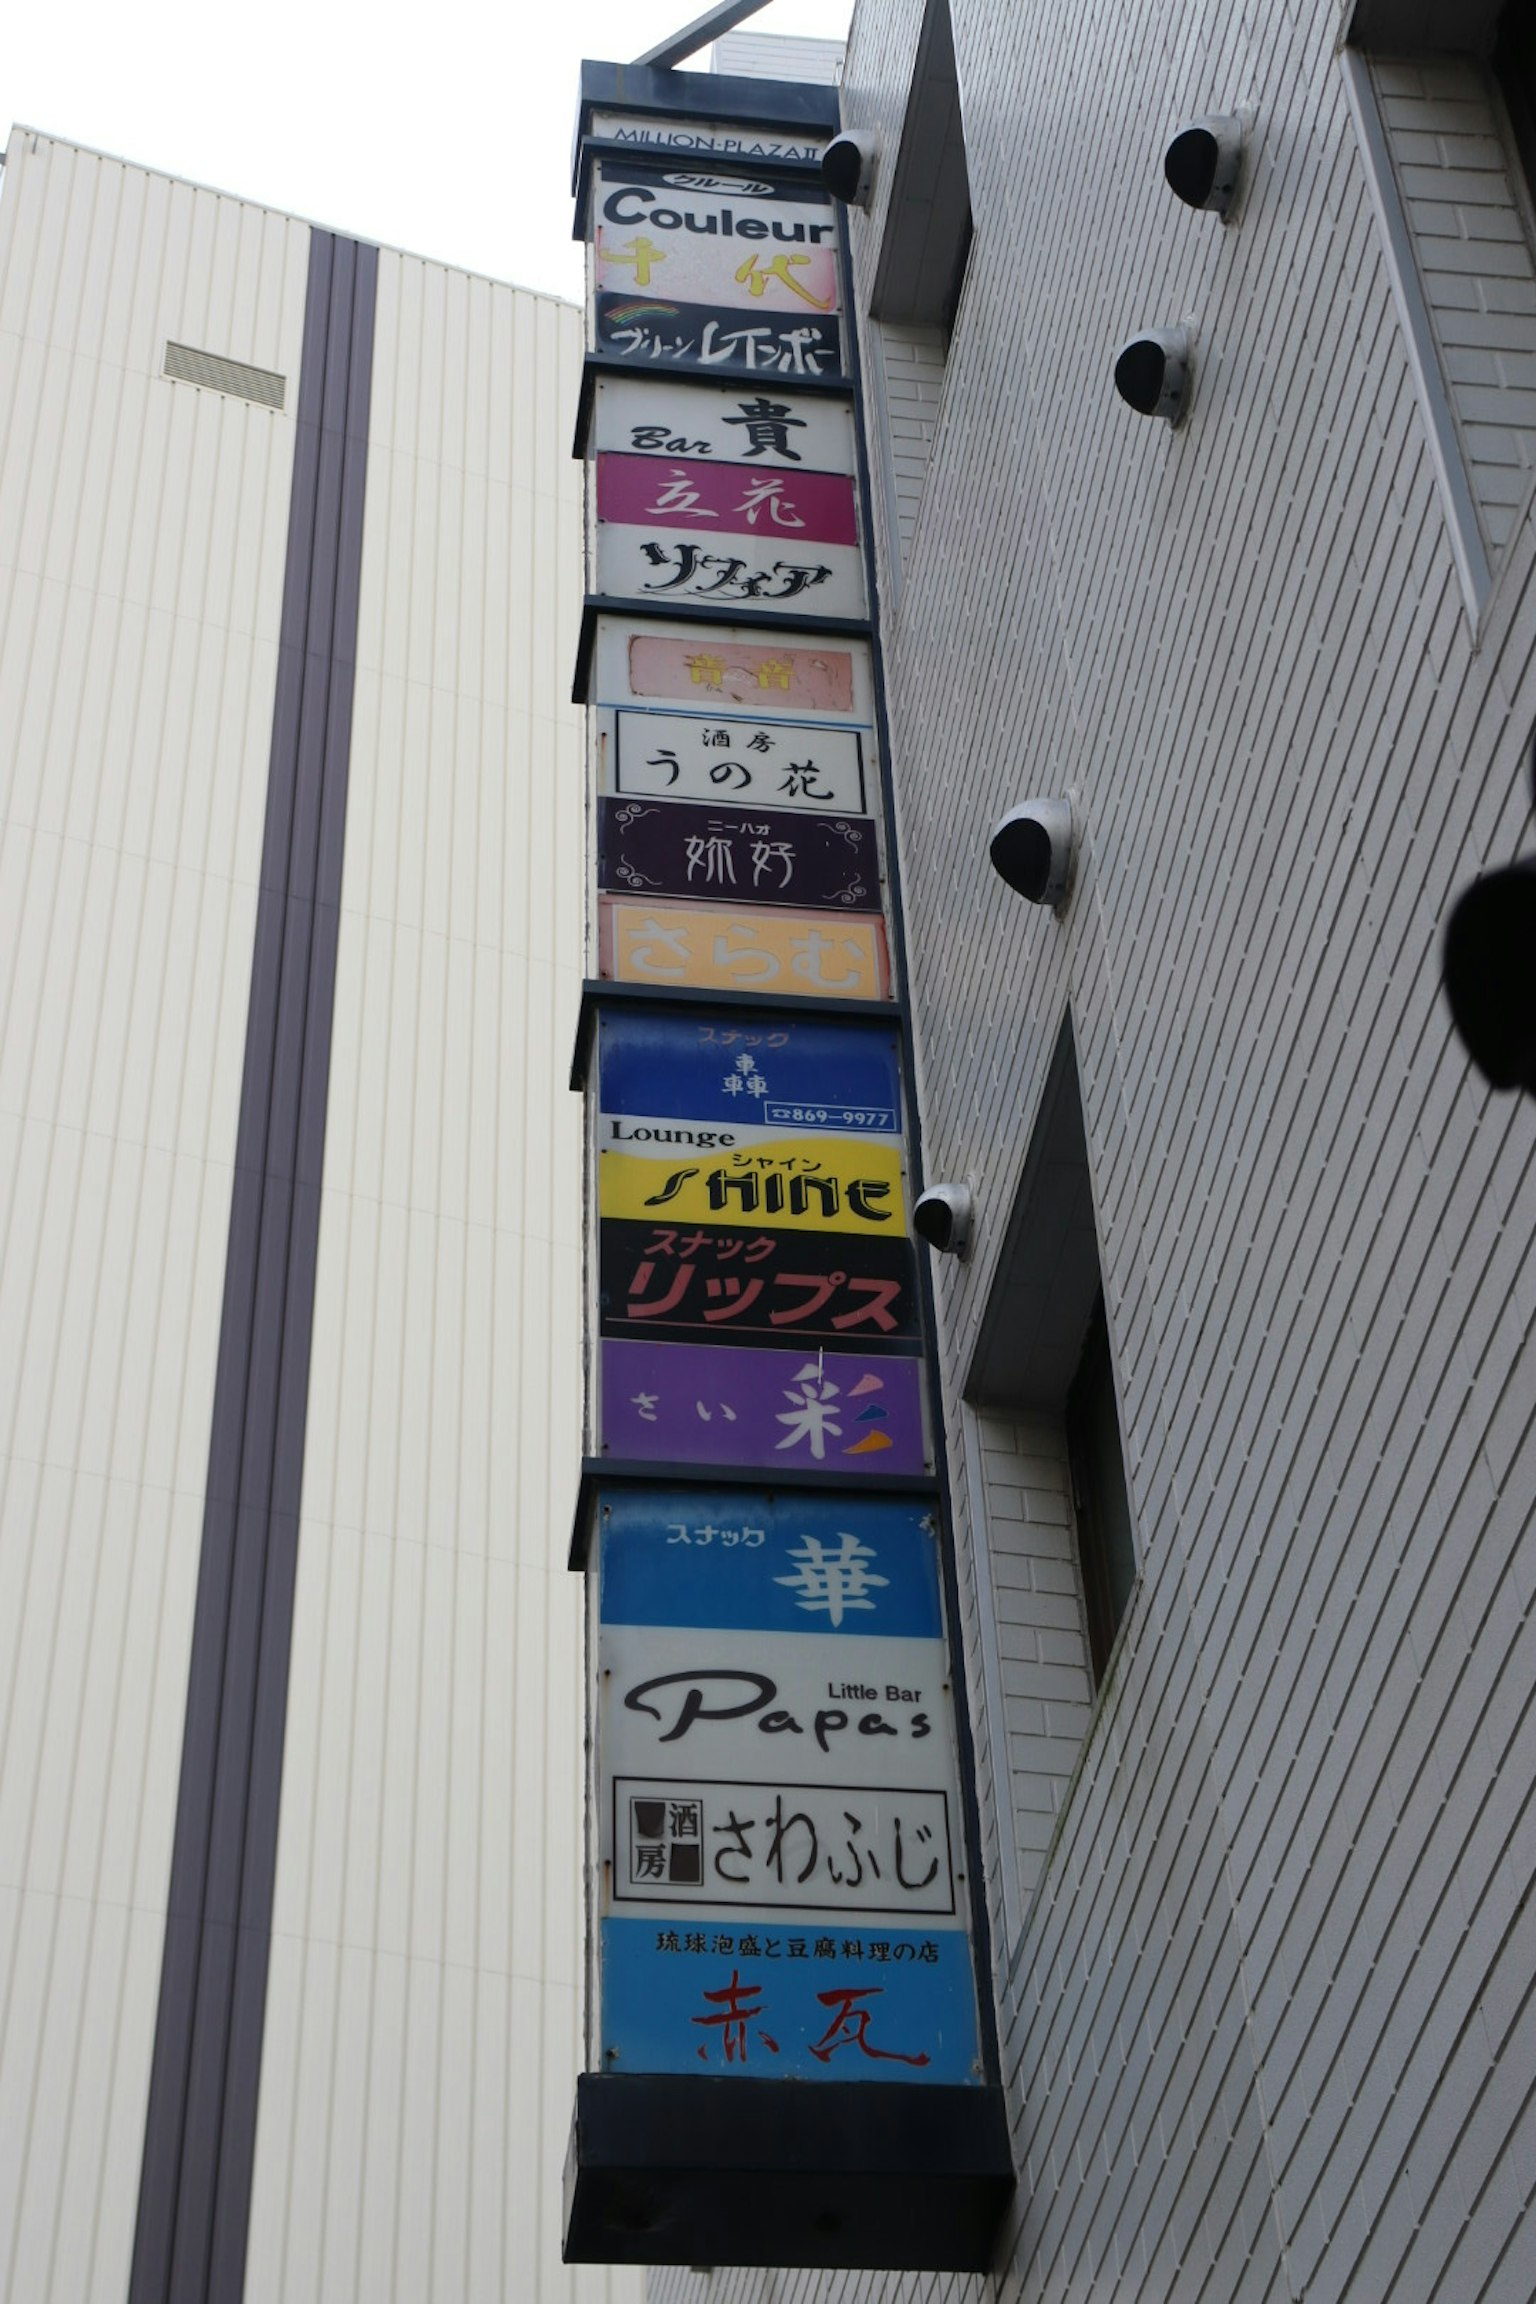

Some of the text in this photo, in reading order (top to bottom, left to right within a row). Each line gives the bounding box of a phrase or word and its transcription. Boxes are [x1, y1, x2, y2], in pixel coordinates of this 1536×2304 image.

[674, 173, 769, 194] クルール
[602, 187, 835, 244] Couleur
[697, 320, 835, 375] レインボー
[631, 397, 807, 461] Bar 貴
[645, 468, 806, 528] 立花
[702, 727, 775, 753] 酒房
[645, 749, 834, 800] うの花
[707, 820, 771, 836] ニーハオ
[625, 916, 865, 989] さらむ
[700, 1026, 791, 1049] スナック
[611, 1120, 736, 1149] Lounge
[792, 1108, 889, 1126] 869-9977
[732, 1153, 822, 1173] シャイン
[644, 1168, 893, 1222] SHINE
[643, 1229, 777, 1263] スナック
[626, 1261, 902, 1333] リップス
[774, 1362, 894, 1461] 彩
[666, 1524, 891, 1629] スナック 華
[624, 1669, 932, 1754] Papas
[827, 1681, 923, 1704] Little Bar
[712, 1793, 939, 1890] さわふじ
[655, 1930, 940, 1964] 琉球泡盛と豆腐料理の店
[691, 1967, 932, 2067] 赤瓦
